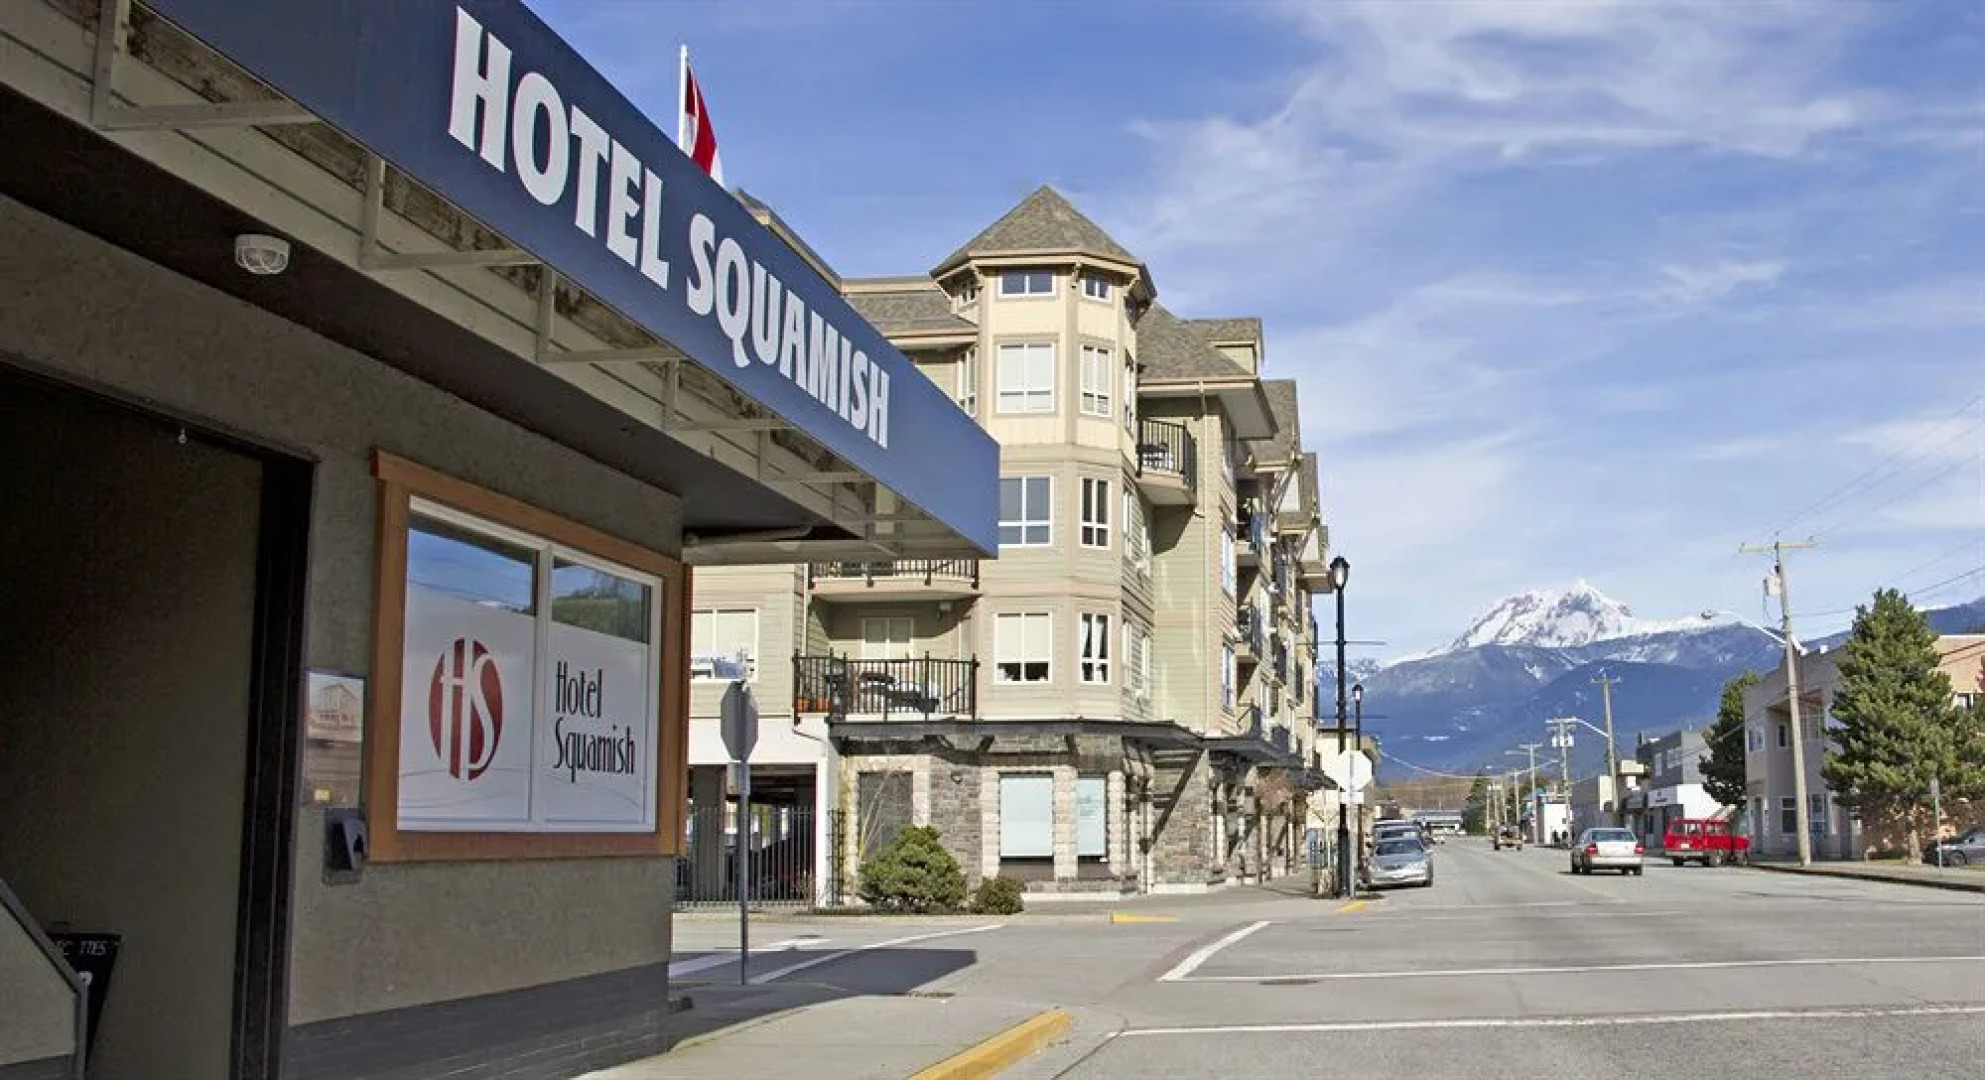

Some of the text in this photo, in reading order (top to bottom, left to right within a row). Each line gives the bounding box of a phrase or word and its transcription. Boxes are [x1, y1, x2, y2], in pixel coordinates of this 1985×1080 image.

[448, 5, 890, 449] HOTEL SQUAMISH
[555, 660, 603, 719] Hotel
[553, 716, 636, 783] Squamish
